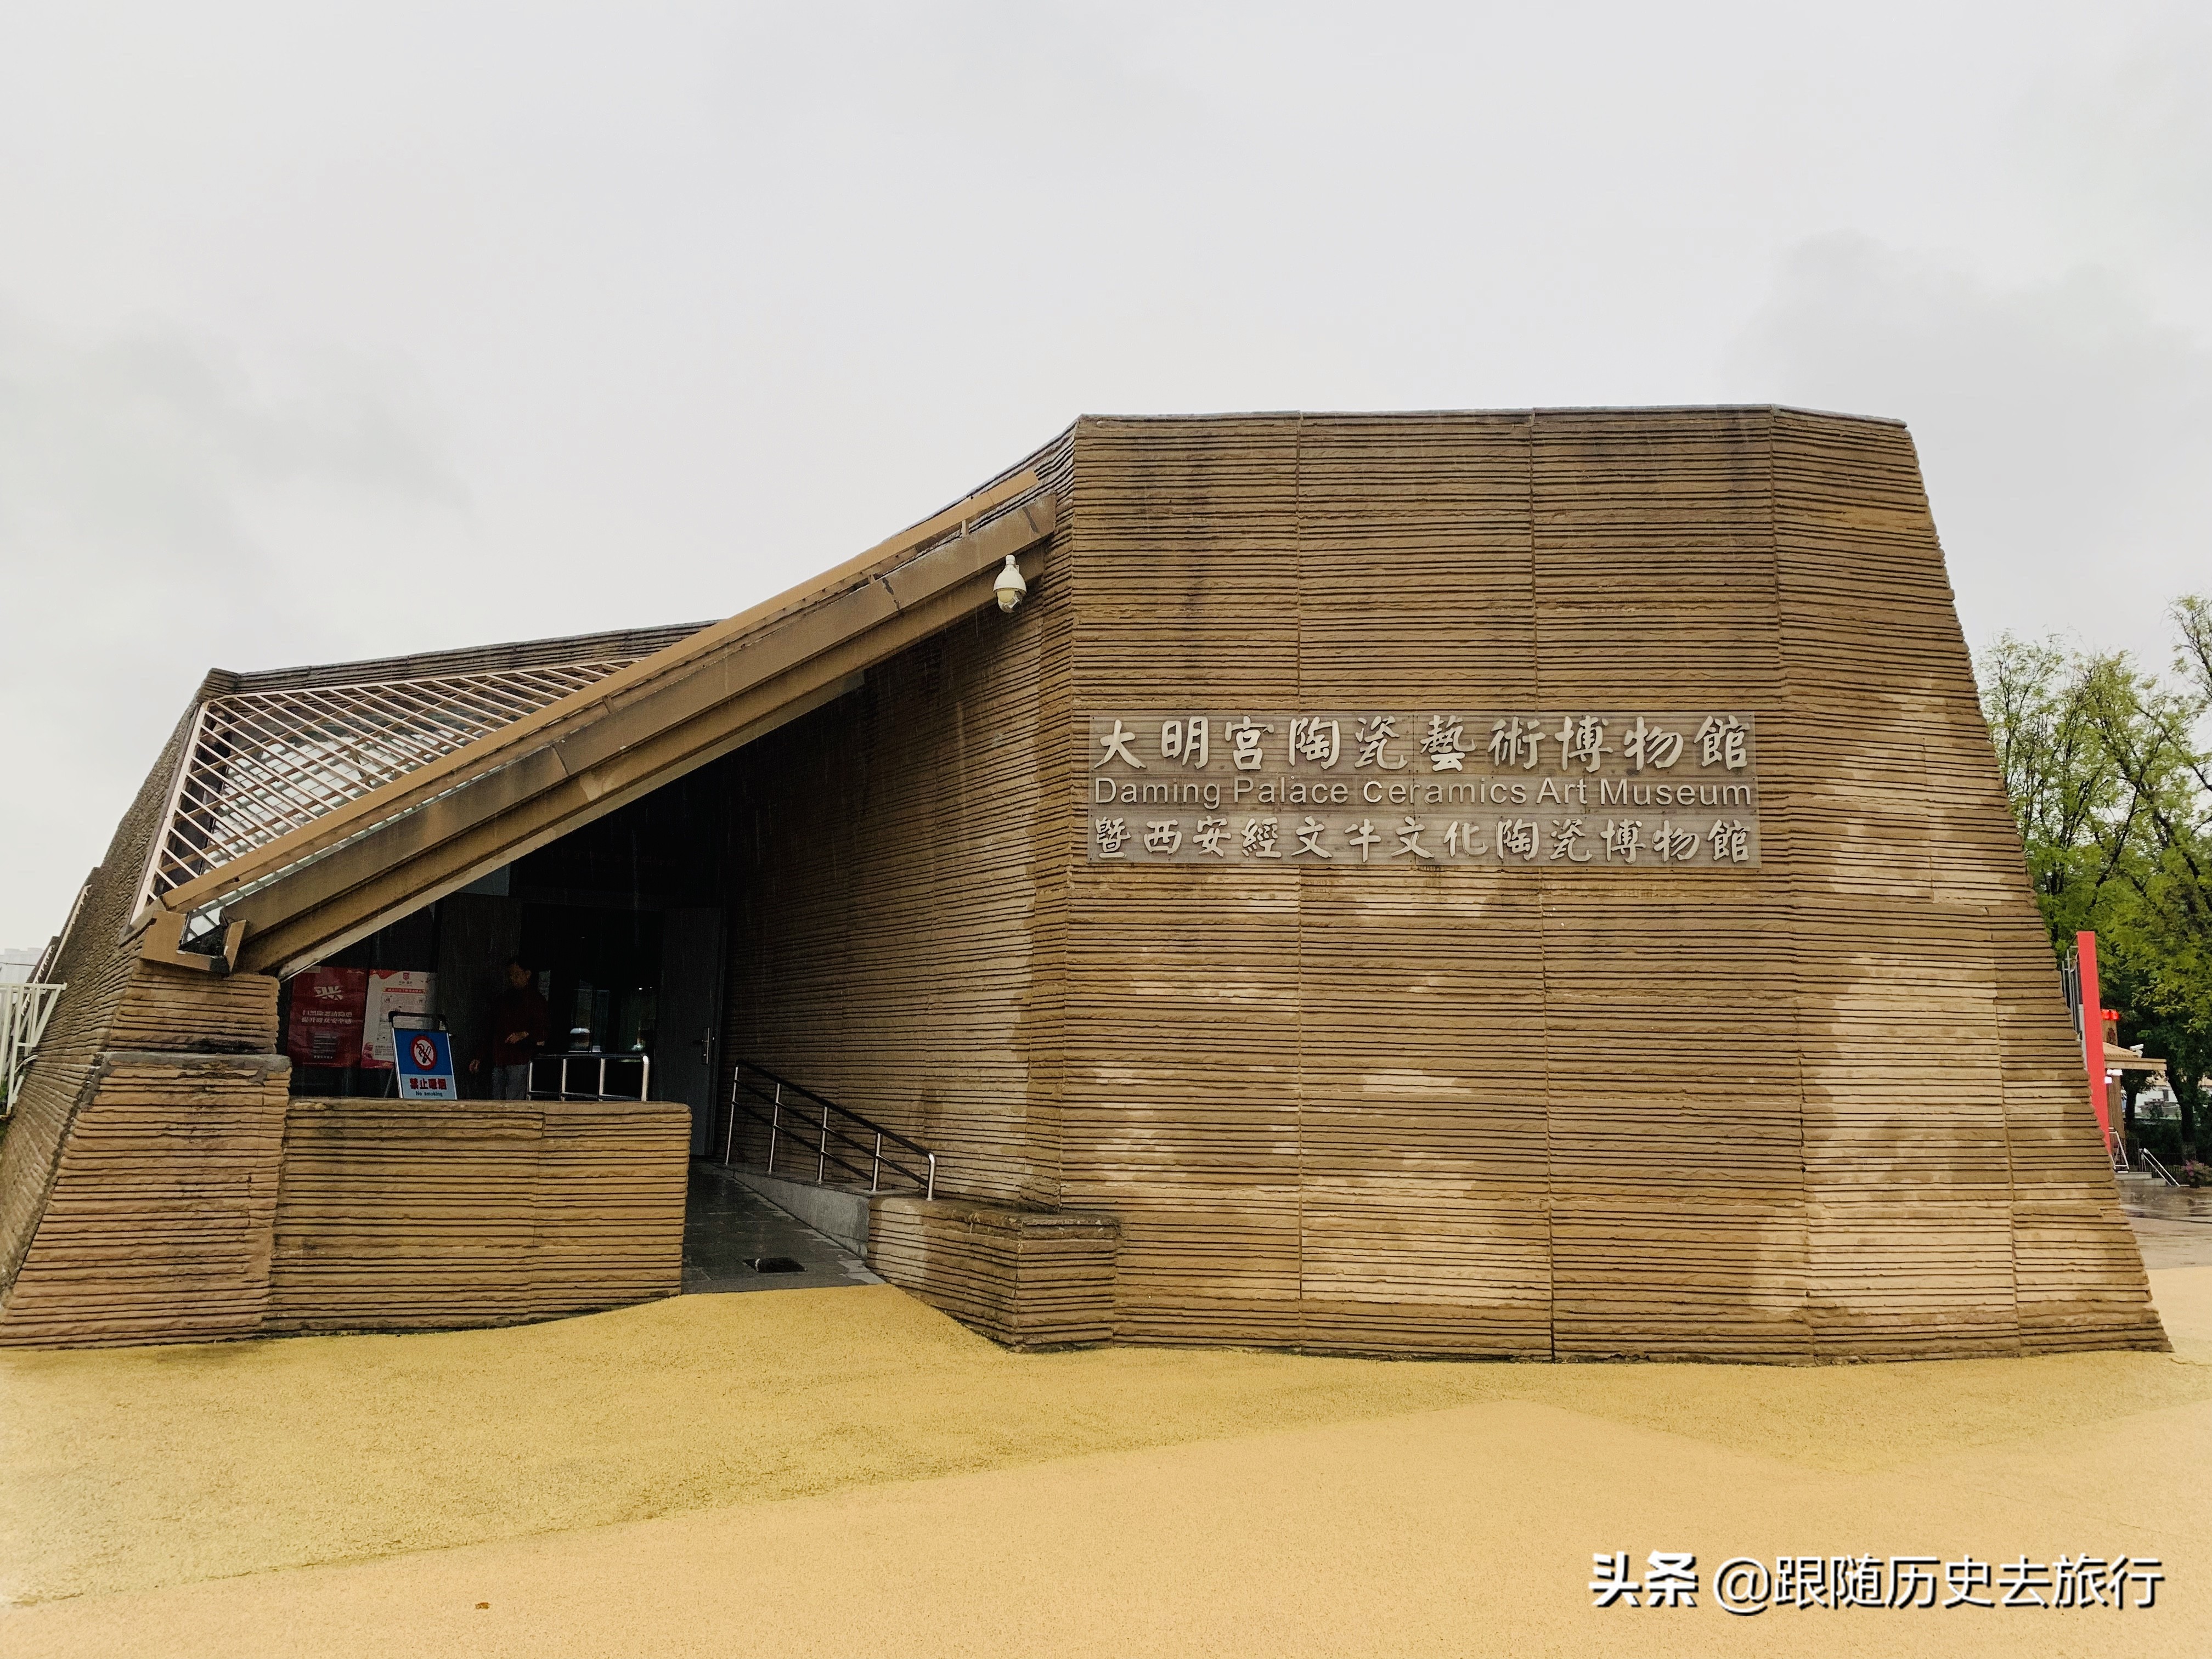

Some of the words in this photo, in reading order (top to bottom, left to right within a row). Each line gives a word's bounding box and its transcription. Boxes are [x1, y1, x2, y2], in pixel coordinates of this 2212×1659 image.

[1095, 777, 1220, 810] Daming
[1234, 776, 1348, 804] Palace
[1363, 777, 1527, 805] Ceramics
[1536, 777, 1588, 805] Art
[1600, 778, 1751, 806] Museum
[409, 1077, 447, 1090] 禁止吸烟
